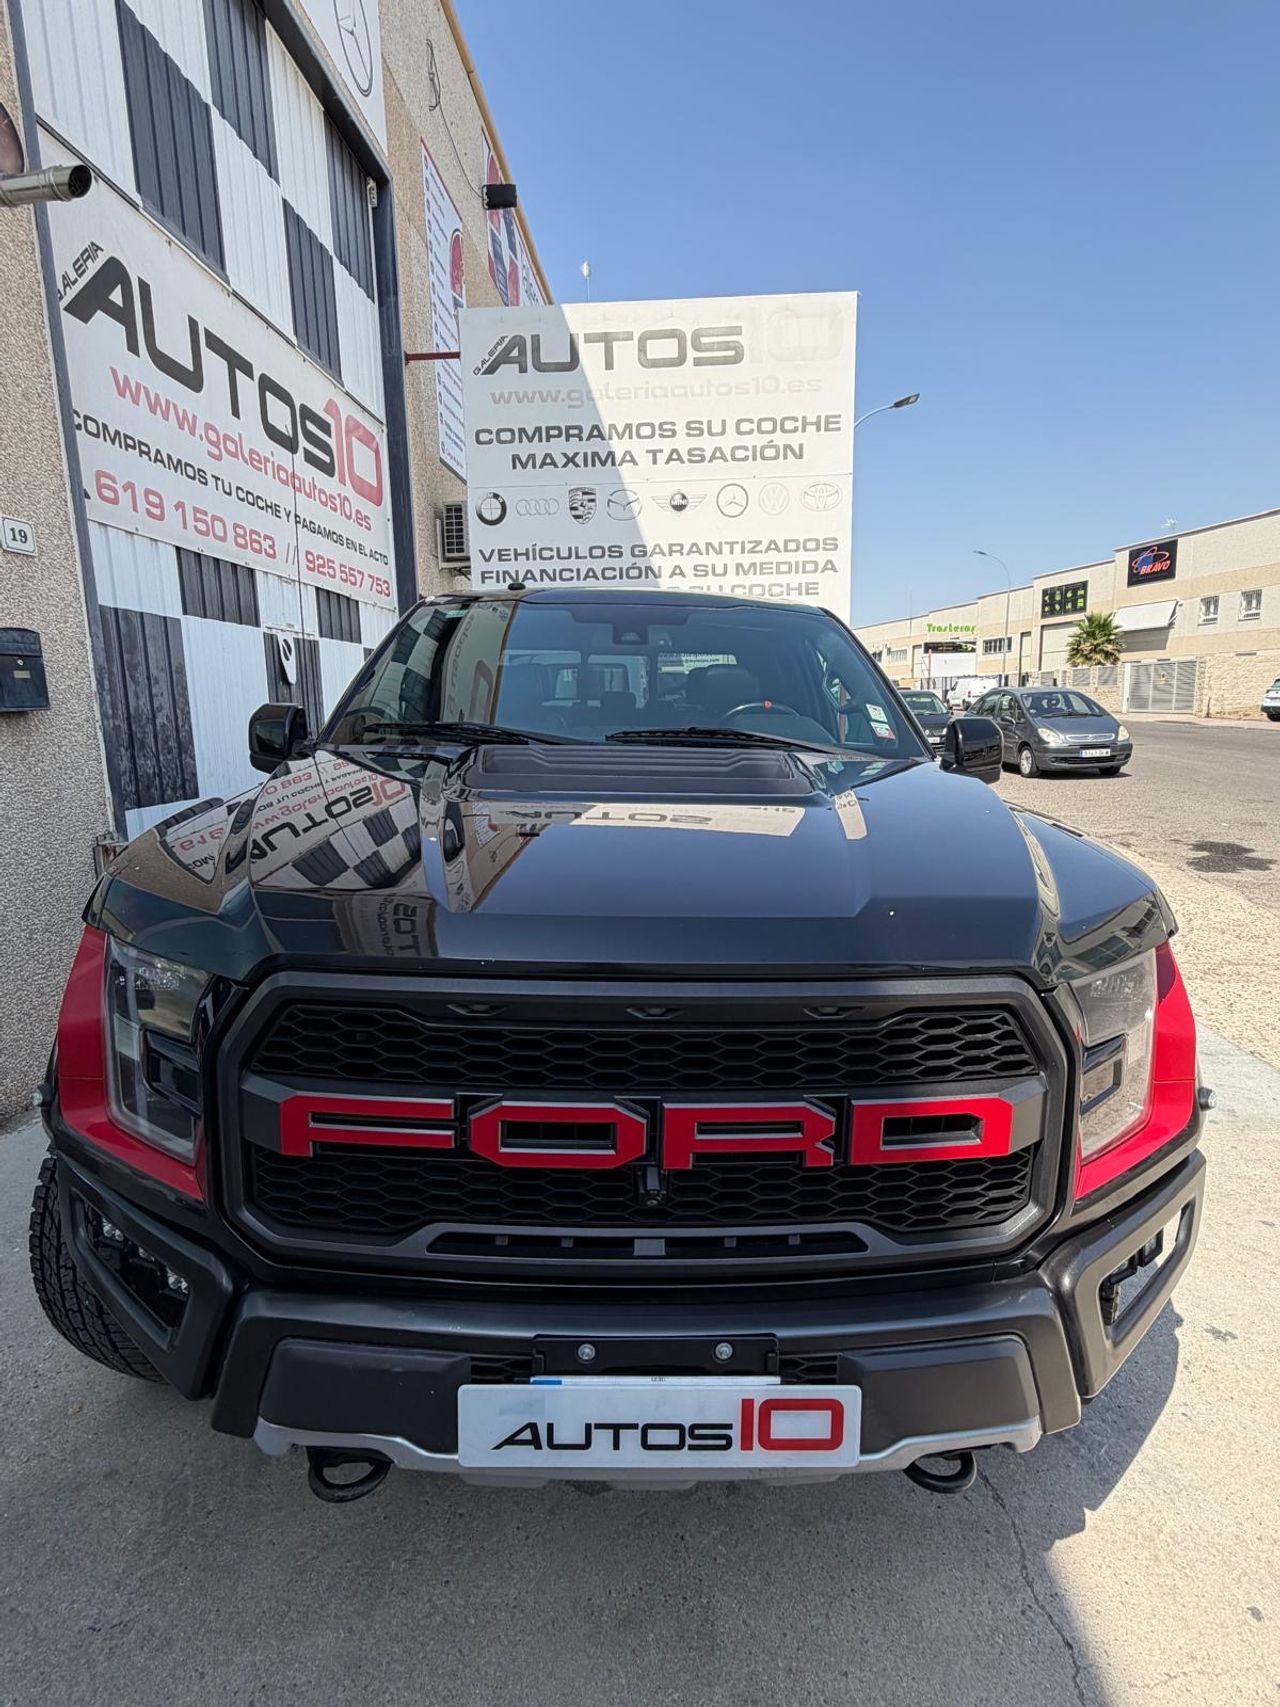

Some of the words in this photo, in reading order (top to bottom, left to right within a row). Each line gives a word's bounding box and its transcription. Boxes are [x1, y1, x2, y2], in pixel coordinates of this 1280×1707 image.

[473, 335, 508, 376] GALERIA
[62, 255, 384, 508] AUTOS10
[110, 366, 373, 532] www.galeriaautos10.es
[475, 421, 678, 446] COMPRAMOS
[685, 418, 727, 439] SU
[735, 414, 842, 436] COCHE
[511, 450, 639, 471] MAXIMA
[645, 440, 804, 467] TASACIÓN
[10, 527, 28, 544] 19
[94, 469, 165, 522] 619
[173, 500, 228, 543] 150
[232, 522, 277, 560] 863
[304, 550, 337, 580] 925
[339, 563, 365, 589] 557
[367, 573, 391, 598] 753
[211, 474, 232, 497] TU
[235, 485, 281, 519] COCHE
[283, 507, 292, 523] Y
[294, 513, 345, 547] PAGAMOS
[345, 538, 358, 553] EN
[358, 545, 369, 558] EL
[369, 550, 389, 566] ACTO
[478, 543, 624, 563] VEHÍCULOS
[630, 536, 839, 559] GARANTIZADOS
[1140, 560, 1171, 575] BRAVO
[480, 562, 662, 584] FINANCIACIÓN
[668, 565, 687, 579] A
[693, 563, 728, 578] SU
[735, 558, 839, 576] MEDIDA
[279, 1093, 1014, 1172] FORD
[490, 1398, 845, 1452] AUTOS10
